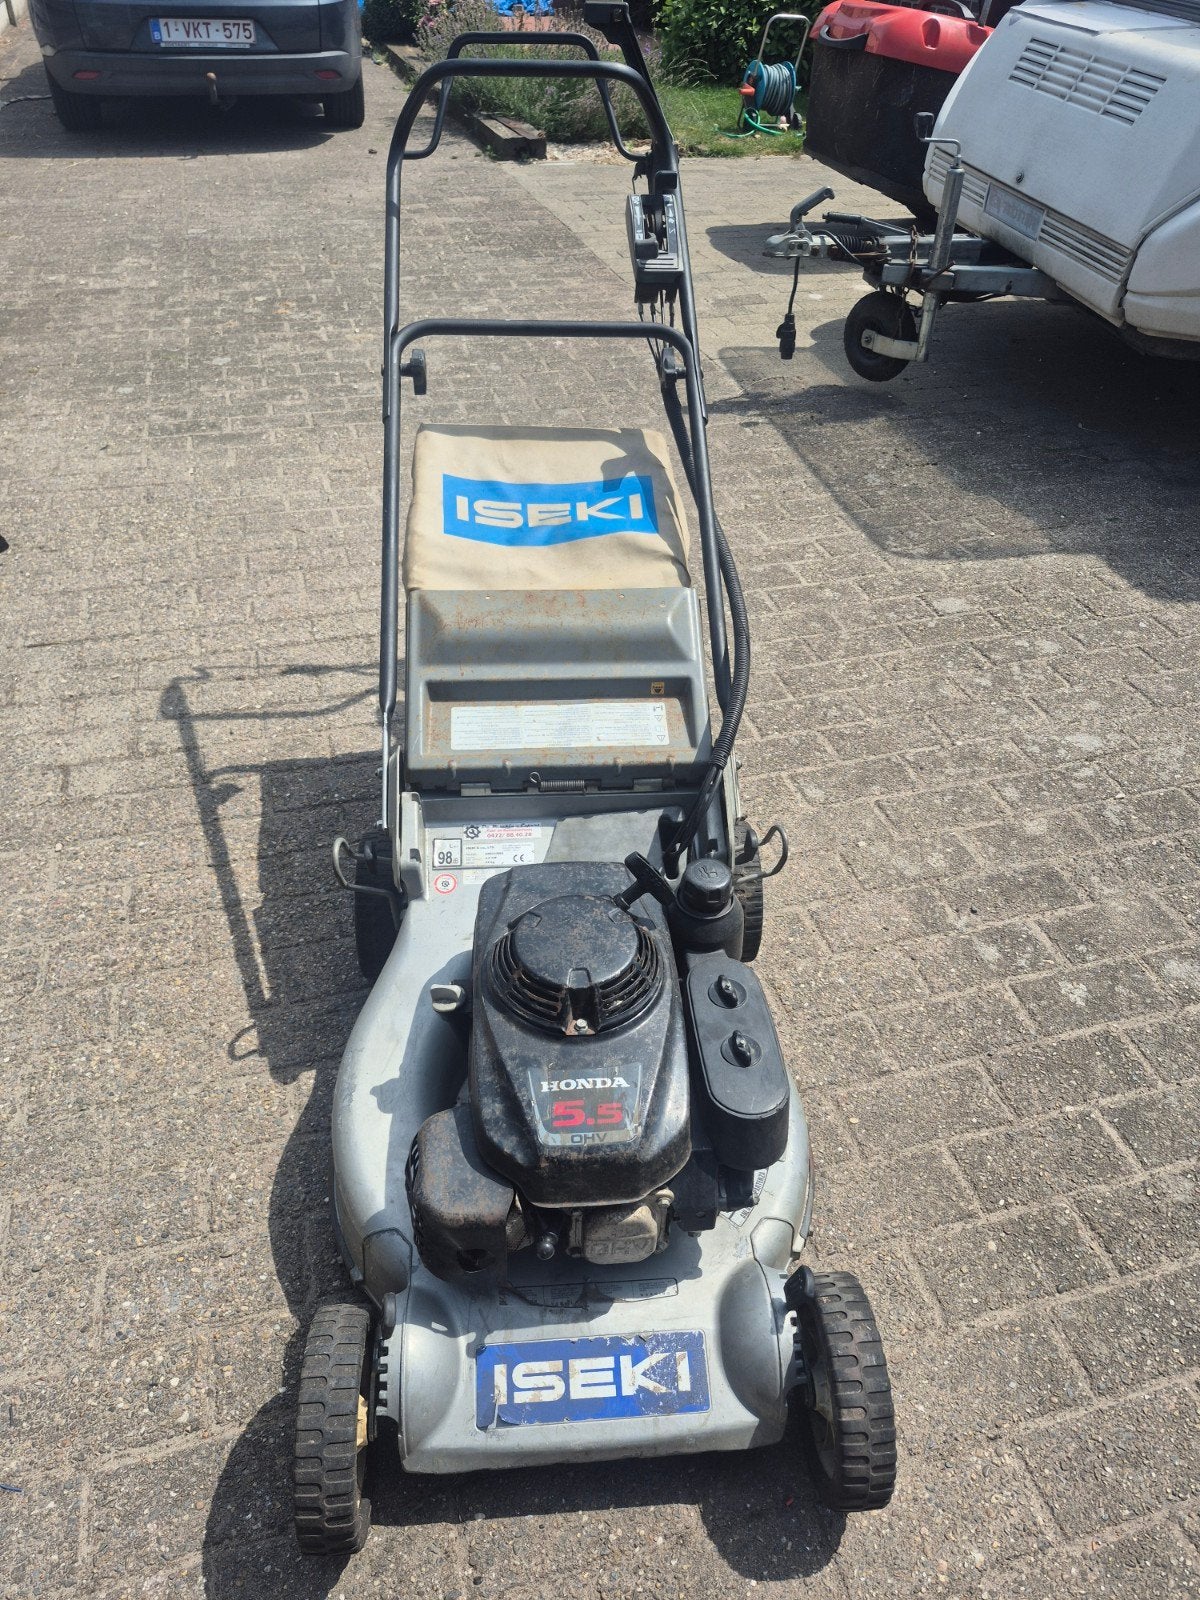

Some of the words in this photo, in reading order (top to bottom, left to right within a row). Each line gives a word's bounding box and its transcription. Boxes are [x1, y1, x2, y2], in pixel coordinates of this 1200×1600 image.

[456, 493, 643, 528] ISEKI
[438, 851, 453, 865] 98
[541, 1076, 630, 1093] HONDA
[552, 1099, 623, 1127] 5.5
[570, 1132, 608, 1145] OHV
[493, 1351, 691, 1405] ISEKI
